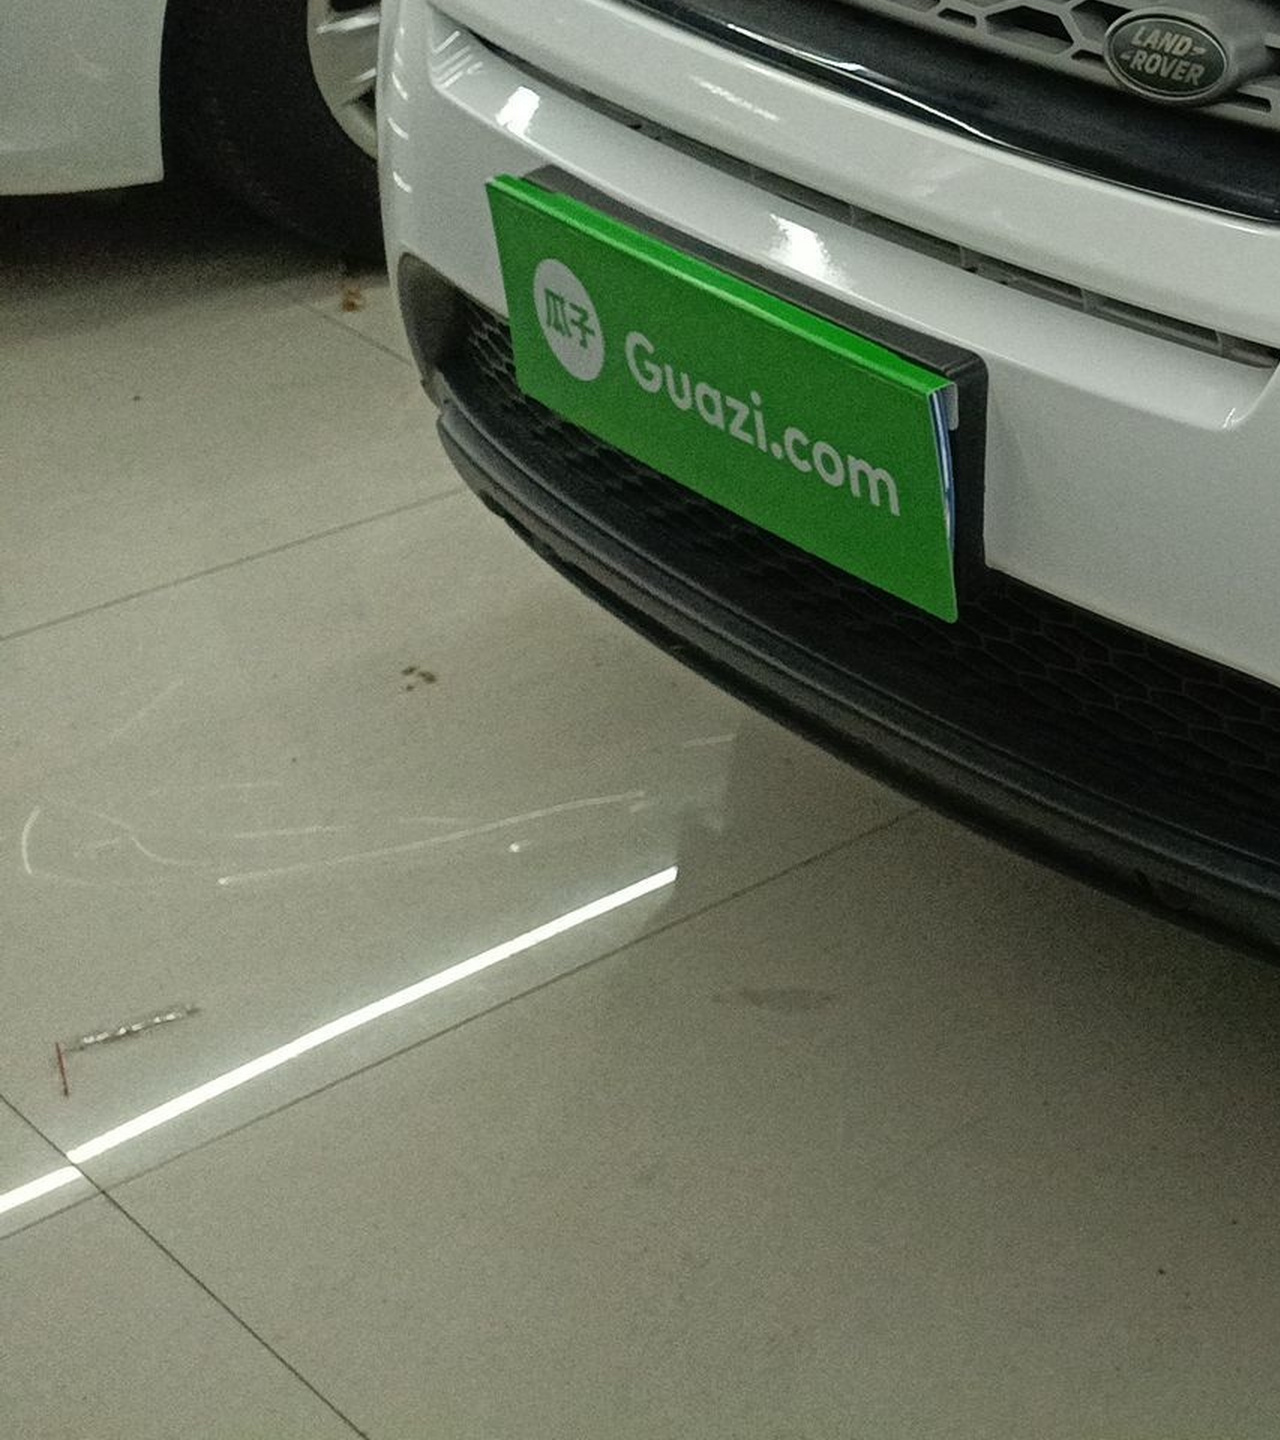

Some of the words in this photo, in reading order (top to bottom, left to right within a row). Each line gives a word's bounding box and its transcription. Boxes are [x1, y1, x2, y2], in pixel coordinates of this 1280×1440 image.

[1131, 25, 1194, 57] LAND
[1129, 49, 1206, 87] ROVER
[544, 287, 596, 349] 瓜子
[625, 330, 901, 517] Guazi.com
